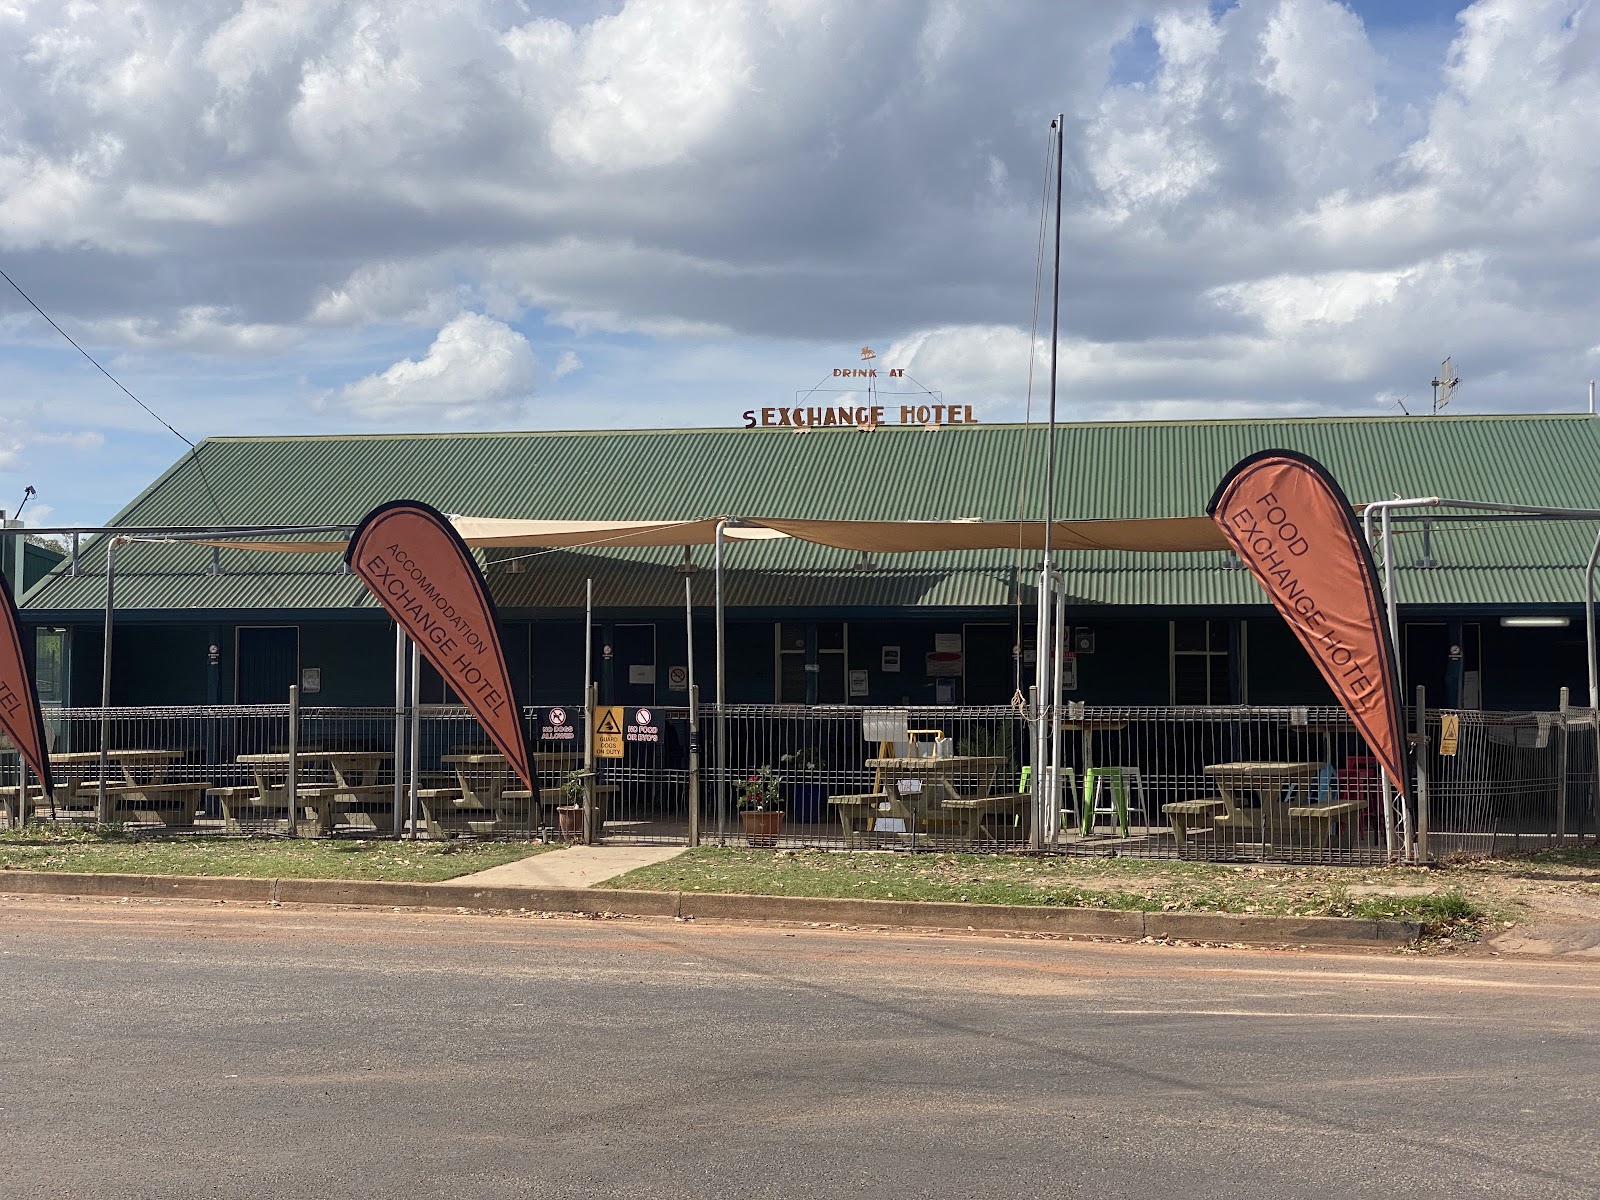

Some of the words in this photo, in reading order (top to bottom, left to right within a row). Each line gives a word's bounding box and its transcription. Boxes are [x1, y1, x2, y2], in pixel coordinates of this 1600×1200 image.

[833, 368, 877, 378] DRINK
[889, 368, 905, 378] AT
[900, 405, 978, 424] HOTEL
[1256, 491, 1309, 557] FOOD
[386, 543, 488, 655] ACCOMMODATION
[1231, 508, 1327, 631] EXCHANGE
[1318, 629, 1376, 711] HOTEL
[366, 555, 458, 657] EXCHANGE
[452, 653, 506, 718] HOTEL
[639, 726, 658, 734] FOOD
